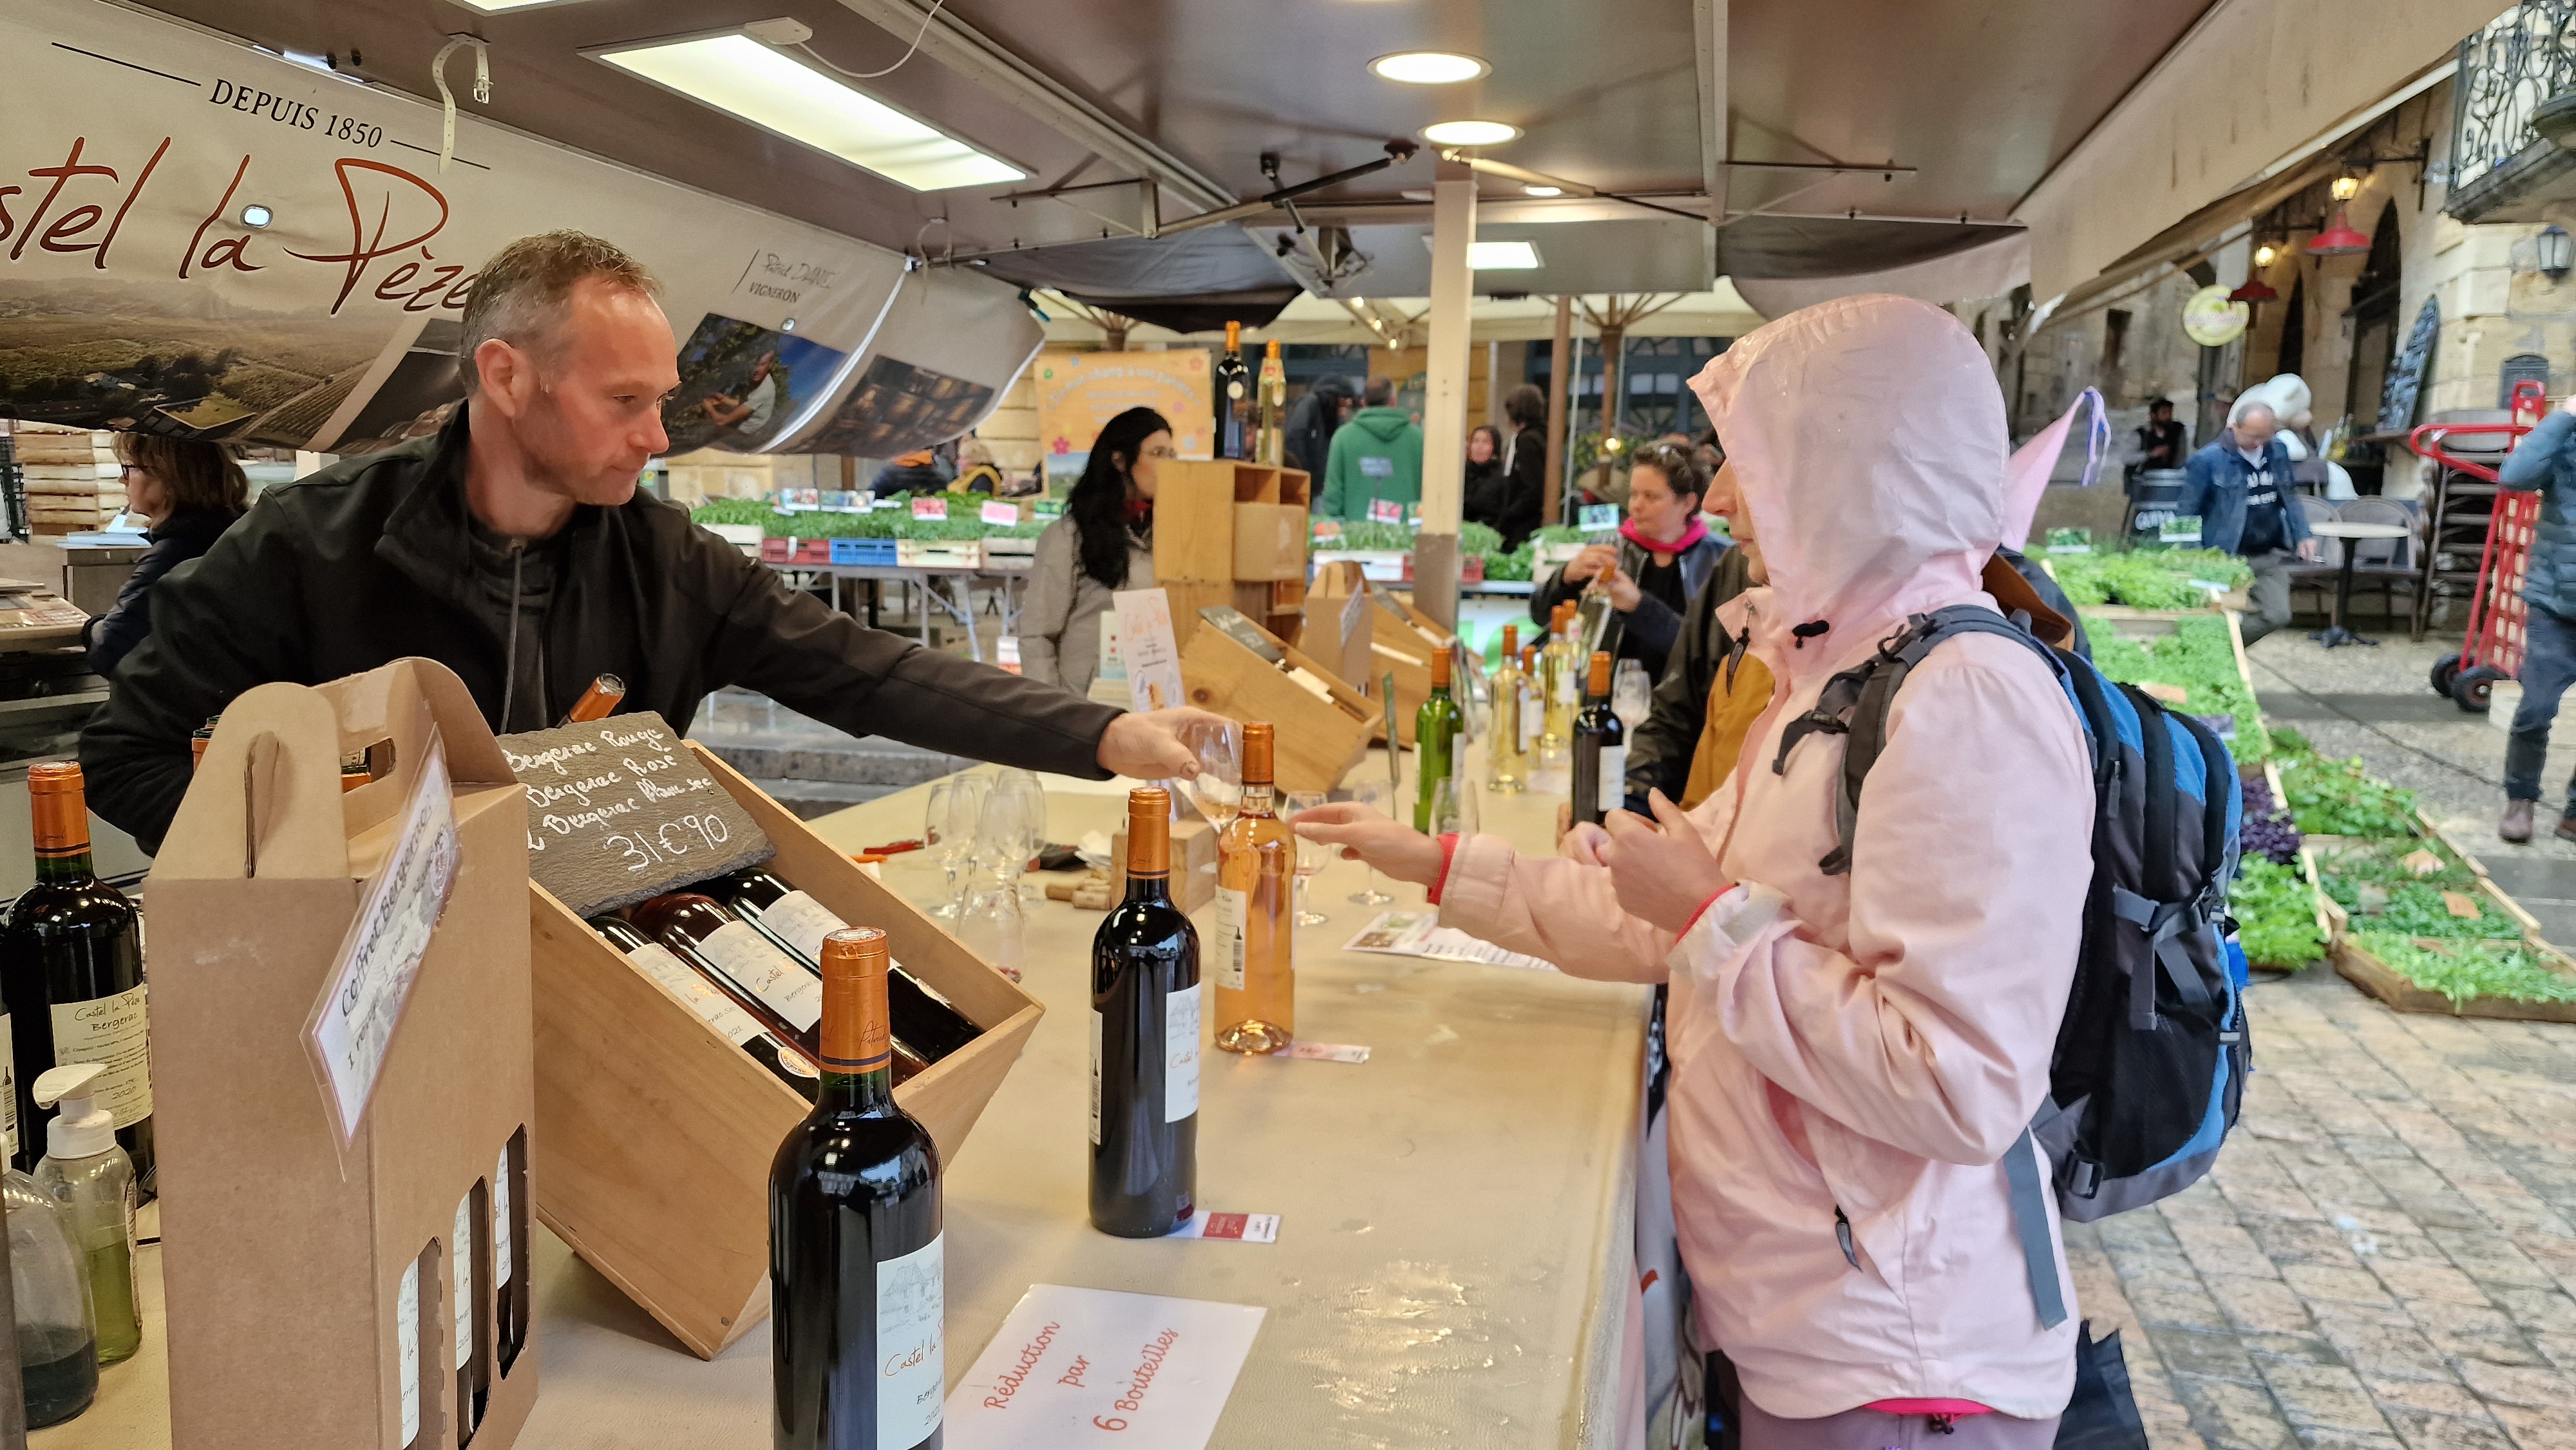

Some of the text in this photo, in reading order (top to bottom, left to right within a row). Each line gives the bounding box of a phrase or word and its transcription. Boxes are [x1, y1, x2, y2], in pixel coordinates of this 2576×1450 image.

[209, 78, 384, 149] DEPUIS 1850
[178, 154, 269, 280] la
[283, 158, 480, 315] Pèze
[748, 281, 800, 304] VIGNERON
[341, 921, 381, 1018] Coffret
[755, 964, 785, 993] Castel
[75, 1003, 106, 1021] Castel
[112, 1000, 120, 1013] la
[91, 1012, 138, 1031] Bergerac
[727, 1026, 743, 1039] 021
[111, 1086, 137, 1100] 2020
[885, 1333, 937, 1377] Castel la
[983, 1321, 1061, 1410] Réduction
[1057, 1355, 1092, 1388] par
[1094, 1327, 1180, 1433] 6 Bouteilles
